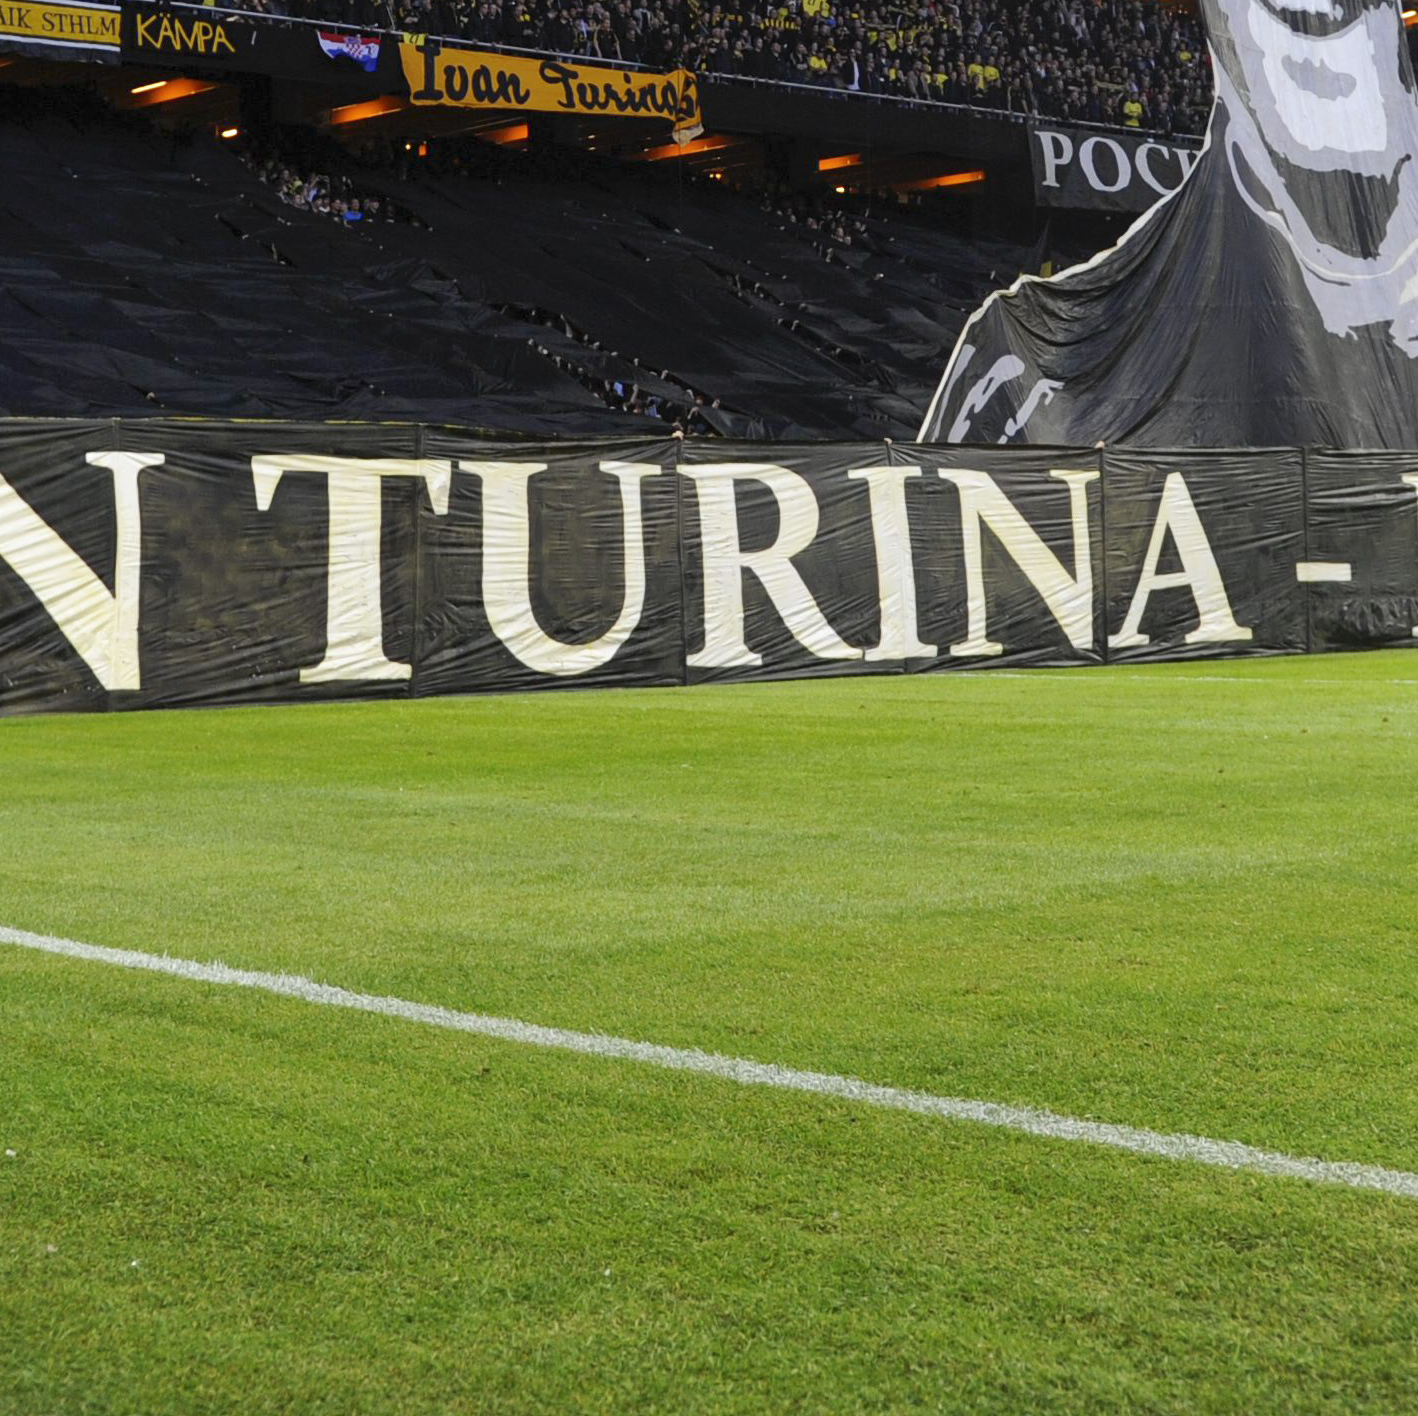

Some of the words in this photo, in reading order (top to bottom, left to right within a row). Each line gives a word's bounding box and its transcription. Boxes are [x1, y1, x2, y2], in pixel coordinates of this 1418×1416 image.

[41, 12, 116, 36] STHLM
[136, 13, 235, 52] KÄMPA
[413, 44, 530, 104] Ivan
[250, 455, 1254, 684] TURINA
